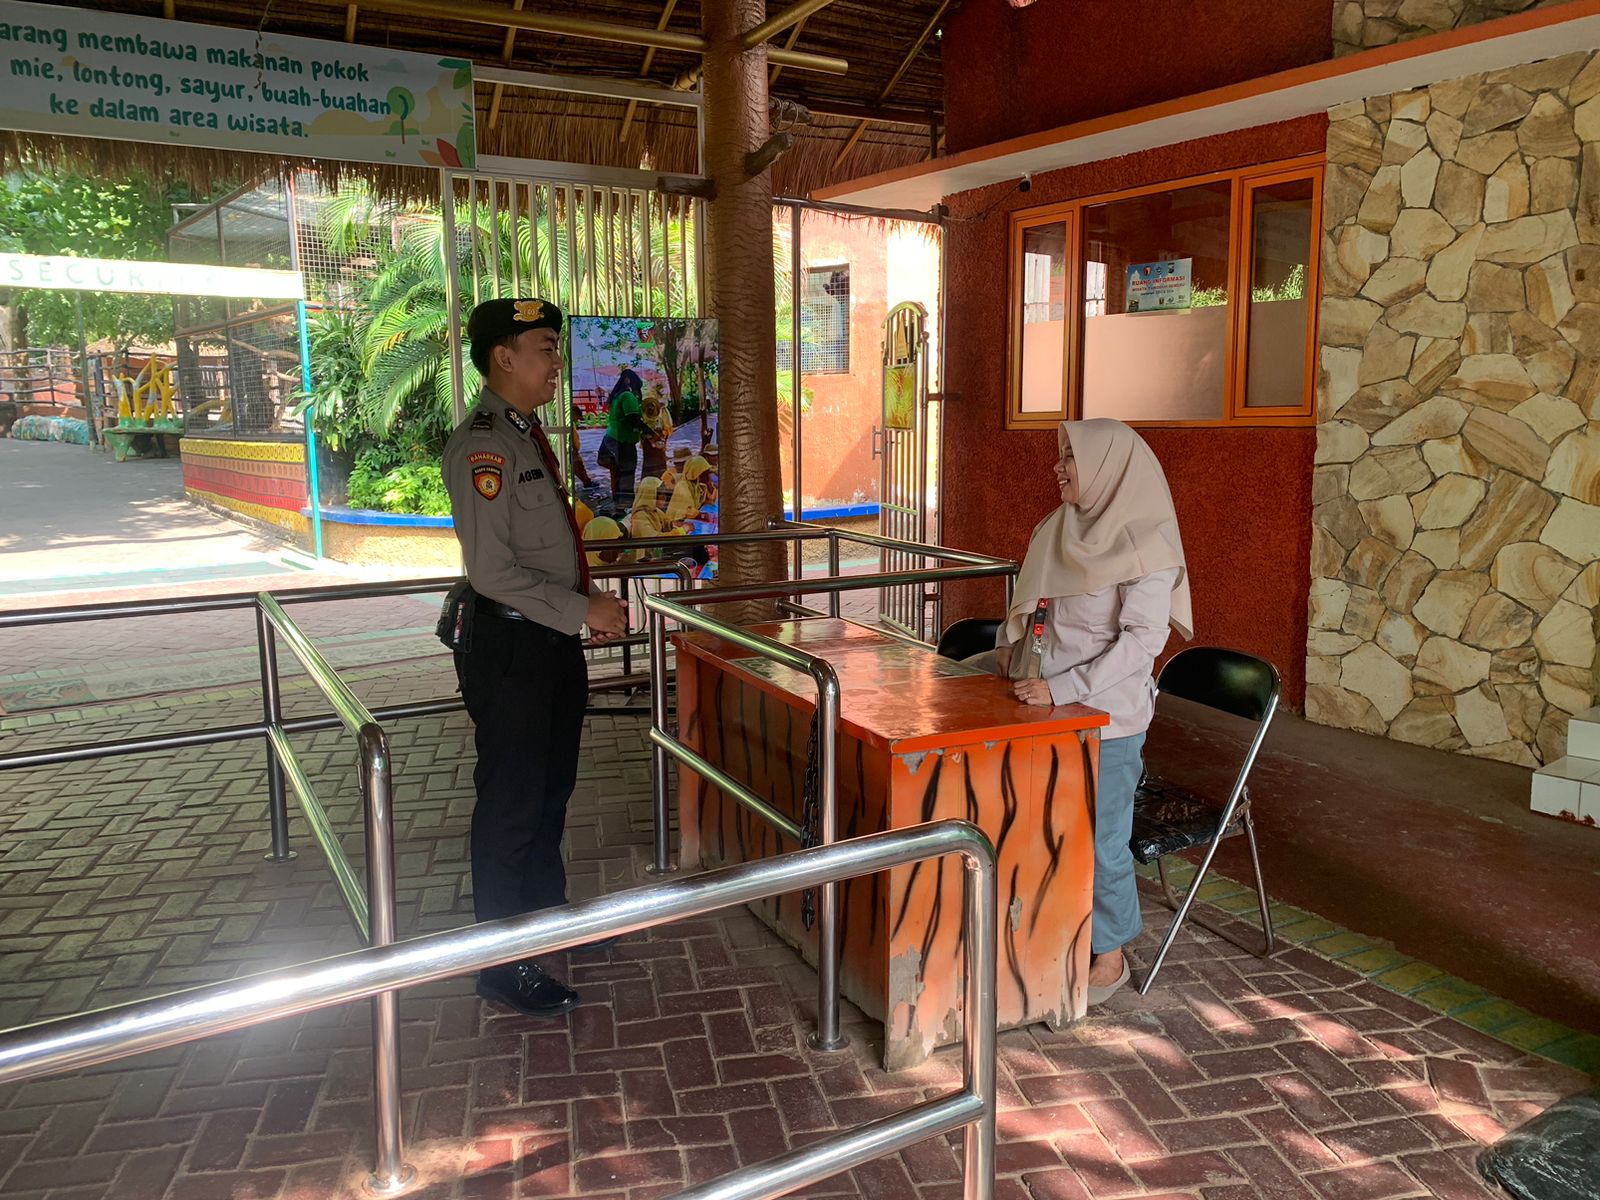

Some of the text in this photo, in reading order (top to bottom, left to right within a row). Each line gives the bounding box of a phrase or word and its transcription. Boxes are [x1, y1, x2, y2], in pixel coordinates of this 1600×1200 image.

[78, 31, 198, 62] membawa
[206, 47, 303, 75] makanan
[311, 59, 369, 82] pokok
[10, 57, 63, 82] mie,
[73, 61, 171, 97] lontong,
[180, 76, 254, 103] sayur,
[49, 93, 309, 138] ke dalam area wisata.
[9, 259, 212, 288] SECUR
